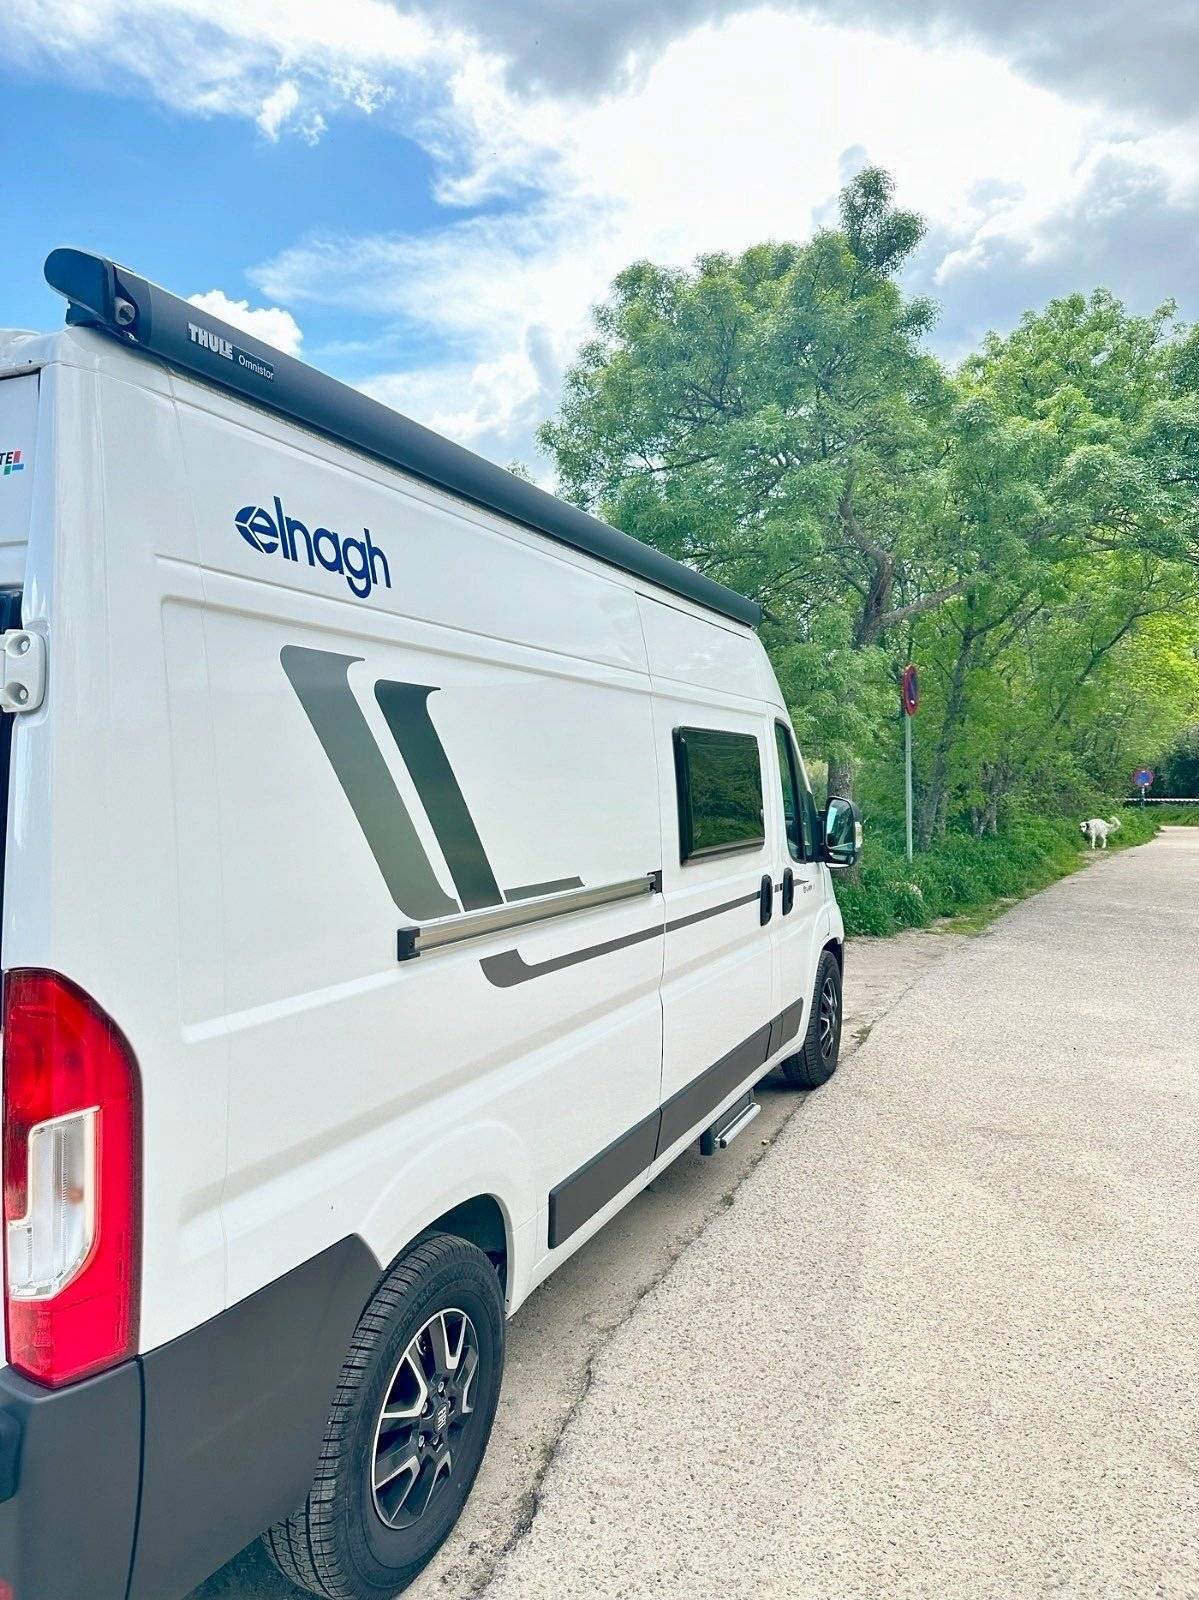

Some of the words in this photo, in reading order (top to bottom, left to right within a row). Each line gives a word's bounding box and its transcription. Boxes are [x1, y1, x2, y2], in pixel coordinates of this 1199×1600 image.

[187, 321, 233, 361] THULE
[238, 354, 274, 380] Omnistor
[234, 495, 392, 599] elnagh
